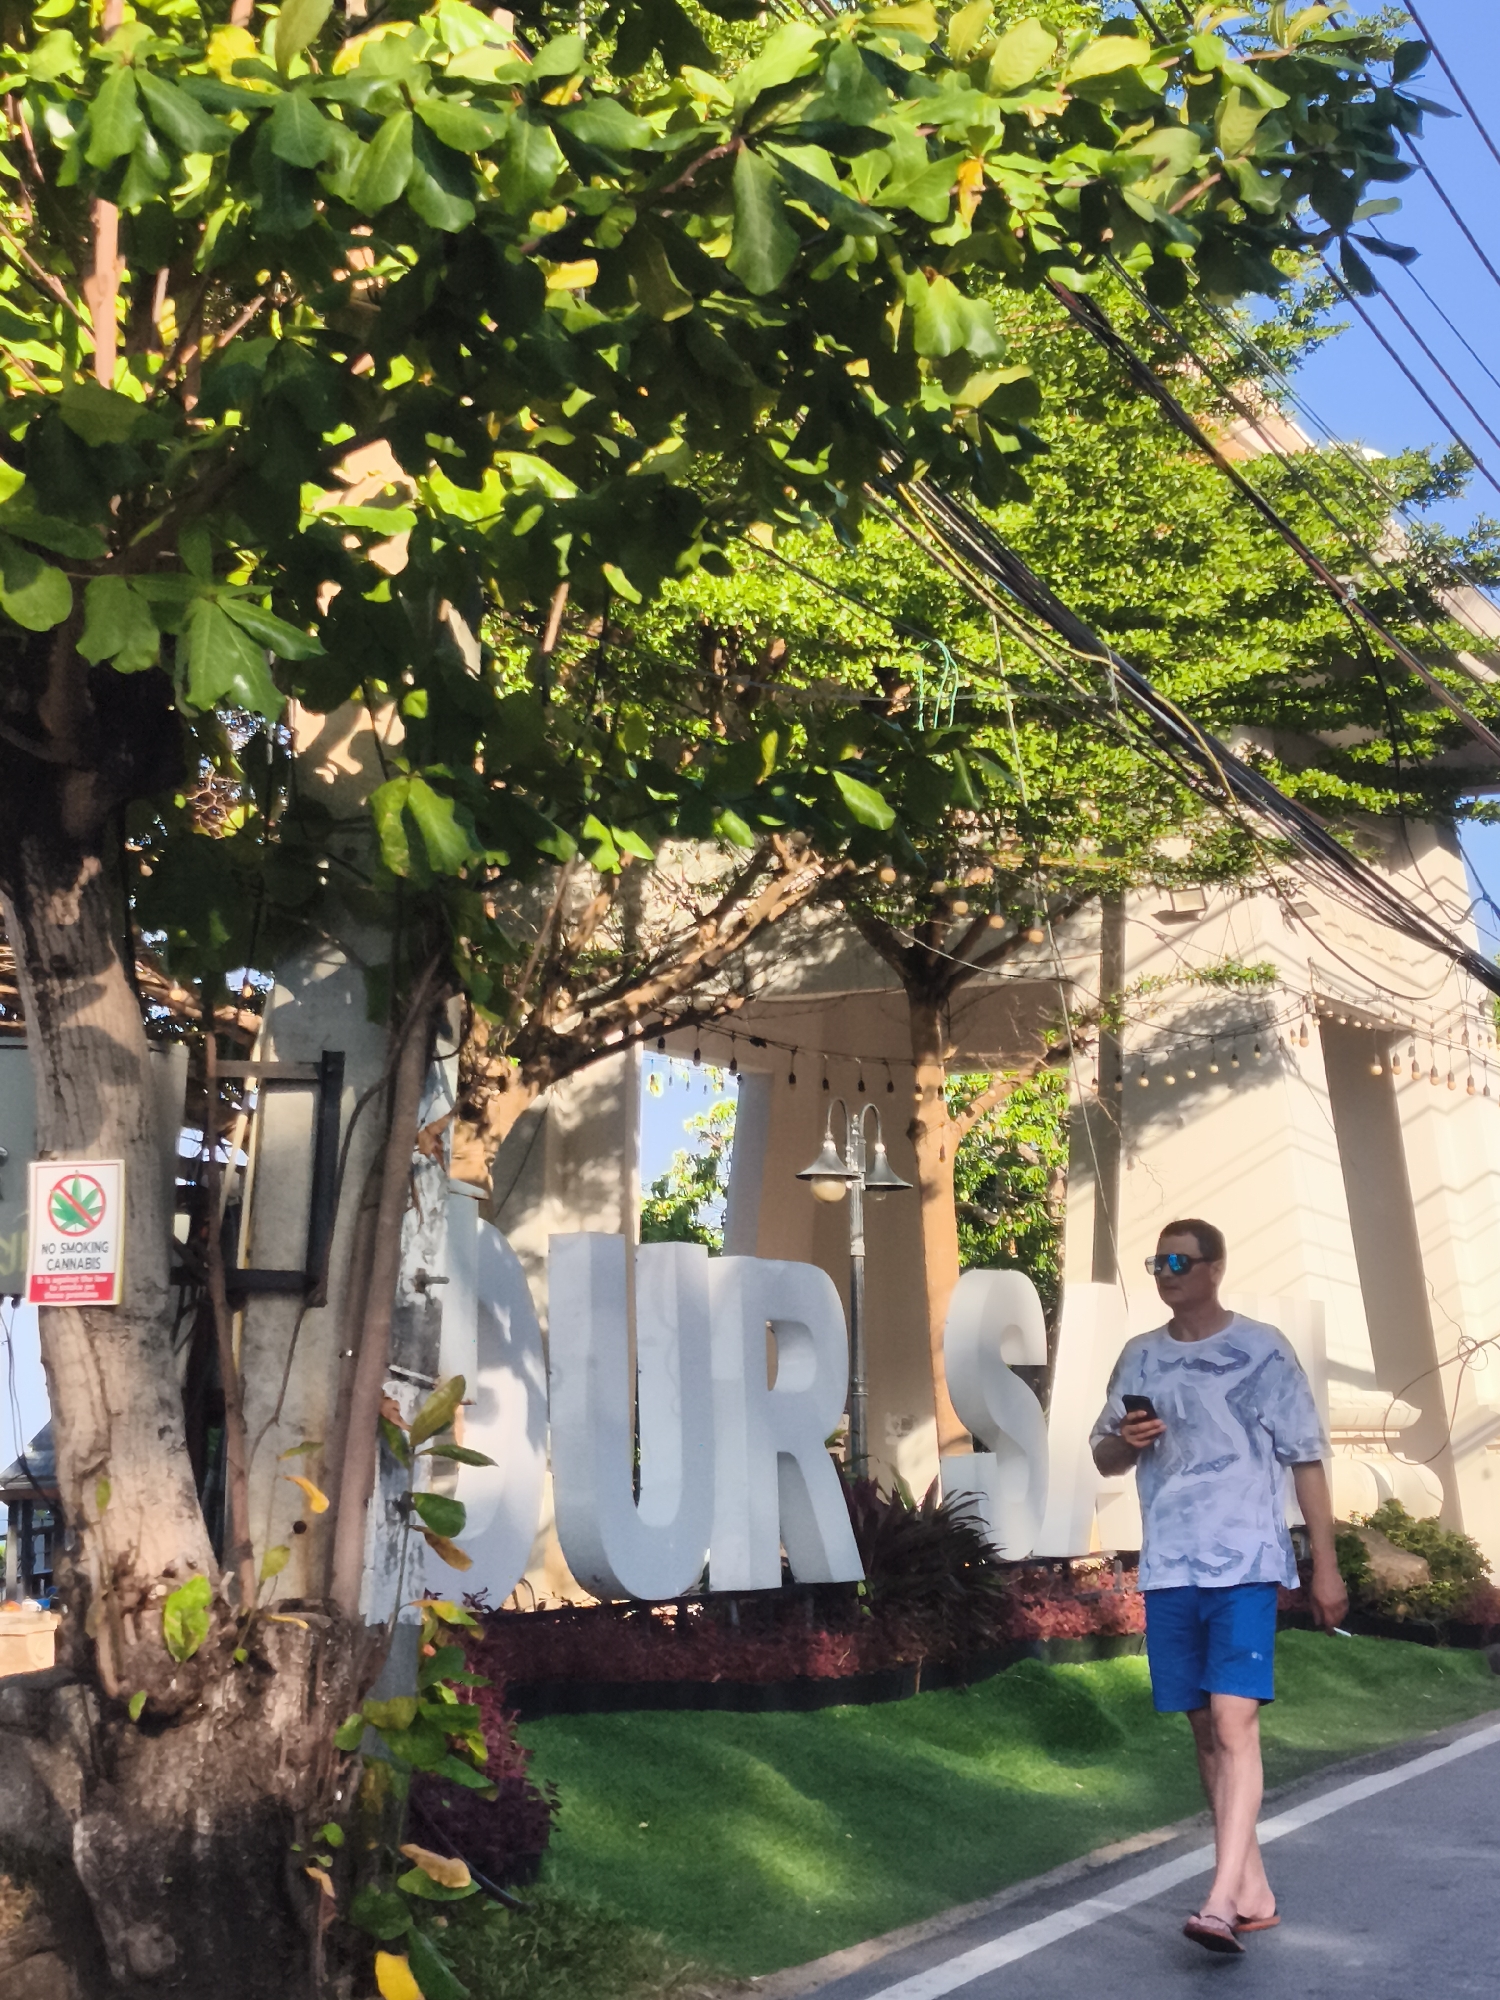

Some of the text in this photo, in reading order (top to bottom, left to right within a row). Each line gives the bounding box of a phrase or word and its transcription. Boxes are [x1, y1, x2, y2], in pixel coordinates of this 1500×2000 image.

[41, 1241, 109, 1255] NO SMOKING
[46, 1257, 101, 1271] CANNABIS
